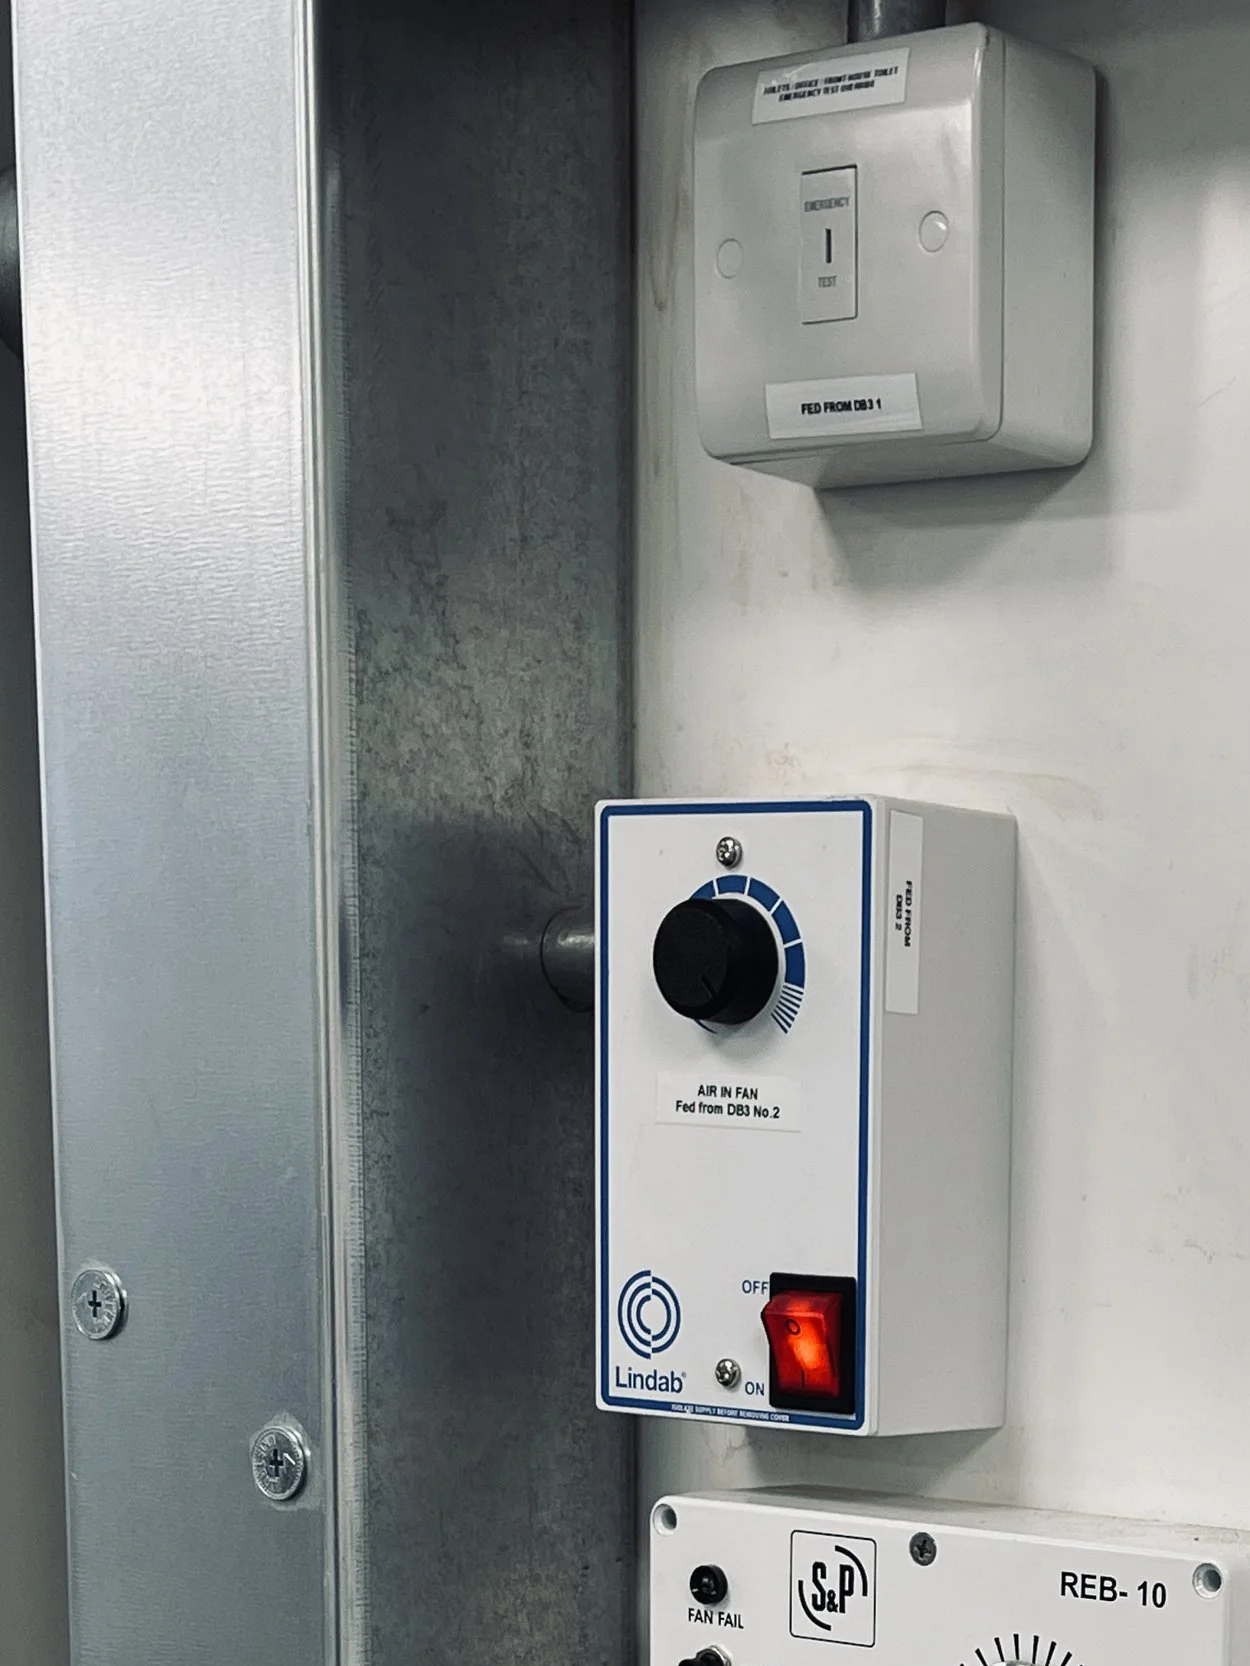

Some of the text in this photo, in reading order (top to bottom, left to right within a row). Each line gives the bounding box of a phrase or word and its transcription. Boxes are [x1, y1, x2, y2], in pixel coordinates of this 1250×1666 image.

[804, 197, 850, 213] EMERGENCY
[817, 275, 838, 288] TEST
[801, 402, 822, 415] FED
[823, 400, 852, 413] FROM
[904, 880, 913, 947] FED FROM
[697, 1084, 758, 1101] AIR IN FAN
[675, 1099, 696, 1114] Fed
[698, 1101, 724, 1115] from
[726, 1103, 751, 1117] DB3
[741, 1279, 769, 1296] OFF
[615, 1365, 684, 1394] Lindab
[744, 1381, 765, 1397] ON
[769, 1413, 790, 1422] COVER
[811, 1561, 855, 1614] S&P
[1060, 1571, 1167, 1608] REB- 10
[688, 1608, 745, 1630] FAN FAIL
